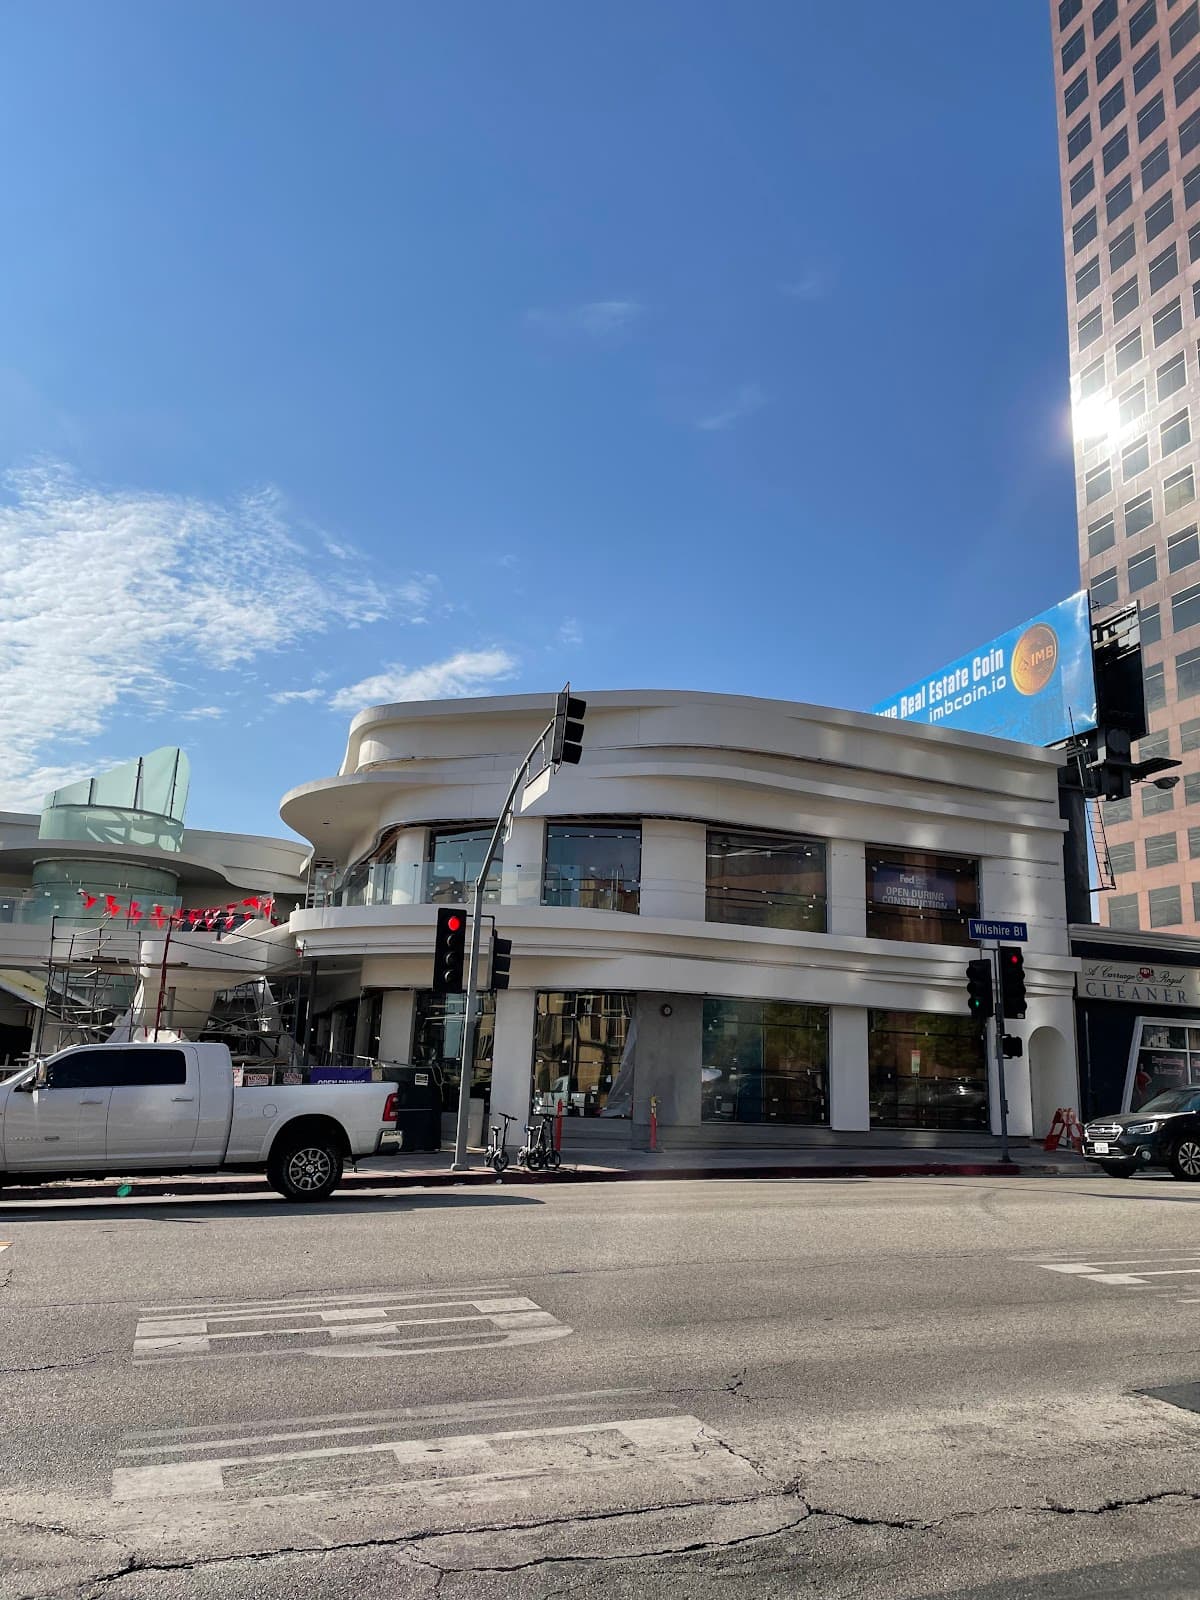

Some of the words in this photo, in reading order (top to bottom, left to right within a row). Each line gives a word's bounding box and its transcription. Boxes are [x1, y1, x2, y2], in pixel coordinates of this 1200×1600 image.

[1031, 645, 1054, 667] IMB
[900, 686, 926, 719] Real
[929, 667, 969, 704] Estate
[972, 648, 1004, 682] Coin
[929, 675, 1007, 723] imbcoin.io
[882, 896, 948, 909] CONSTRUCTION
[886, 887, 909, 897] OPEN
[911, 890, 945, 902] DURING
[974, 923, 1010, 936] Wilshire
[1013, 926, 1023, 937] Bl
